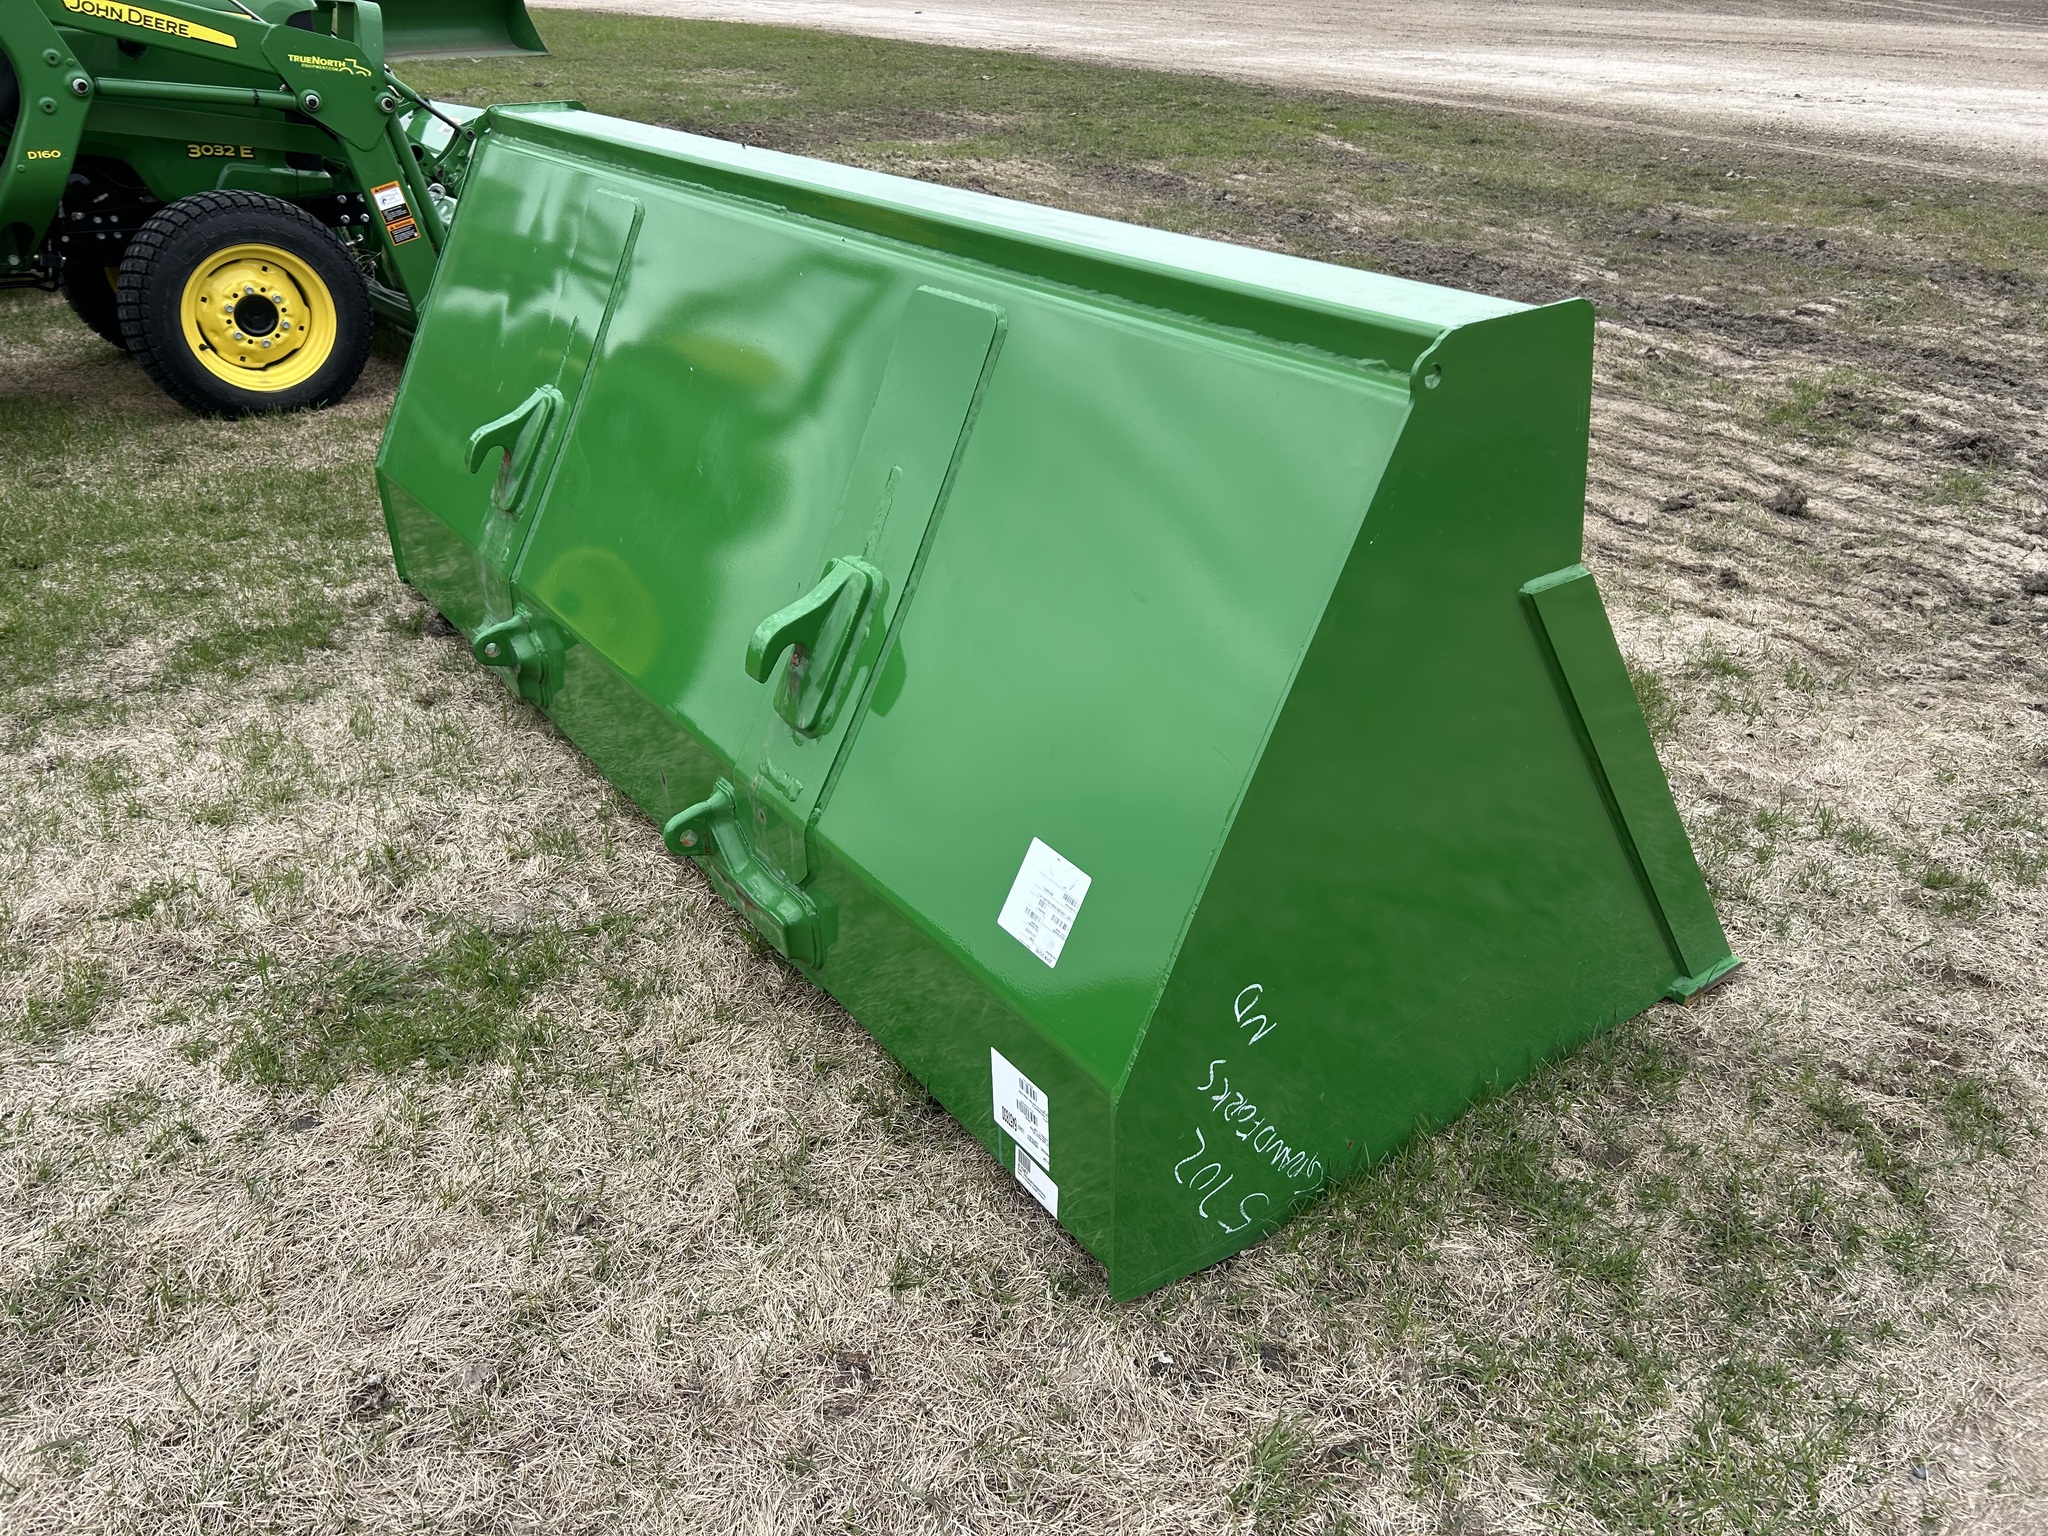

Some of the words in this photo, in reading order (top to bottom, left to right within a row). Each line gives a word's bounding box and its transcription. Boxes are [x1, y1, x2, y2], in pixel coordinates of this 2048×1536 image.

[69, 0, 123, 20] JOHN
[128, 8, 189, 36] DEERE
[27, 150, 62, 160] D160
[187, 144, 236, 158] 3032
[240, 145, 254, 158] E
[1233, 983, 1278, 1046] ND
[1174, 1126, 1270, 1234] 5702
